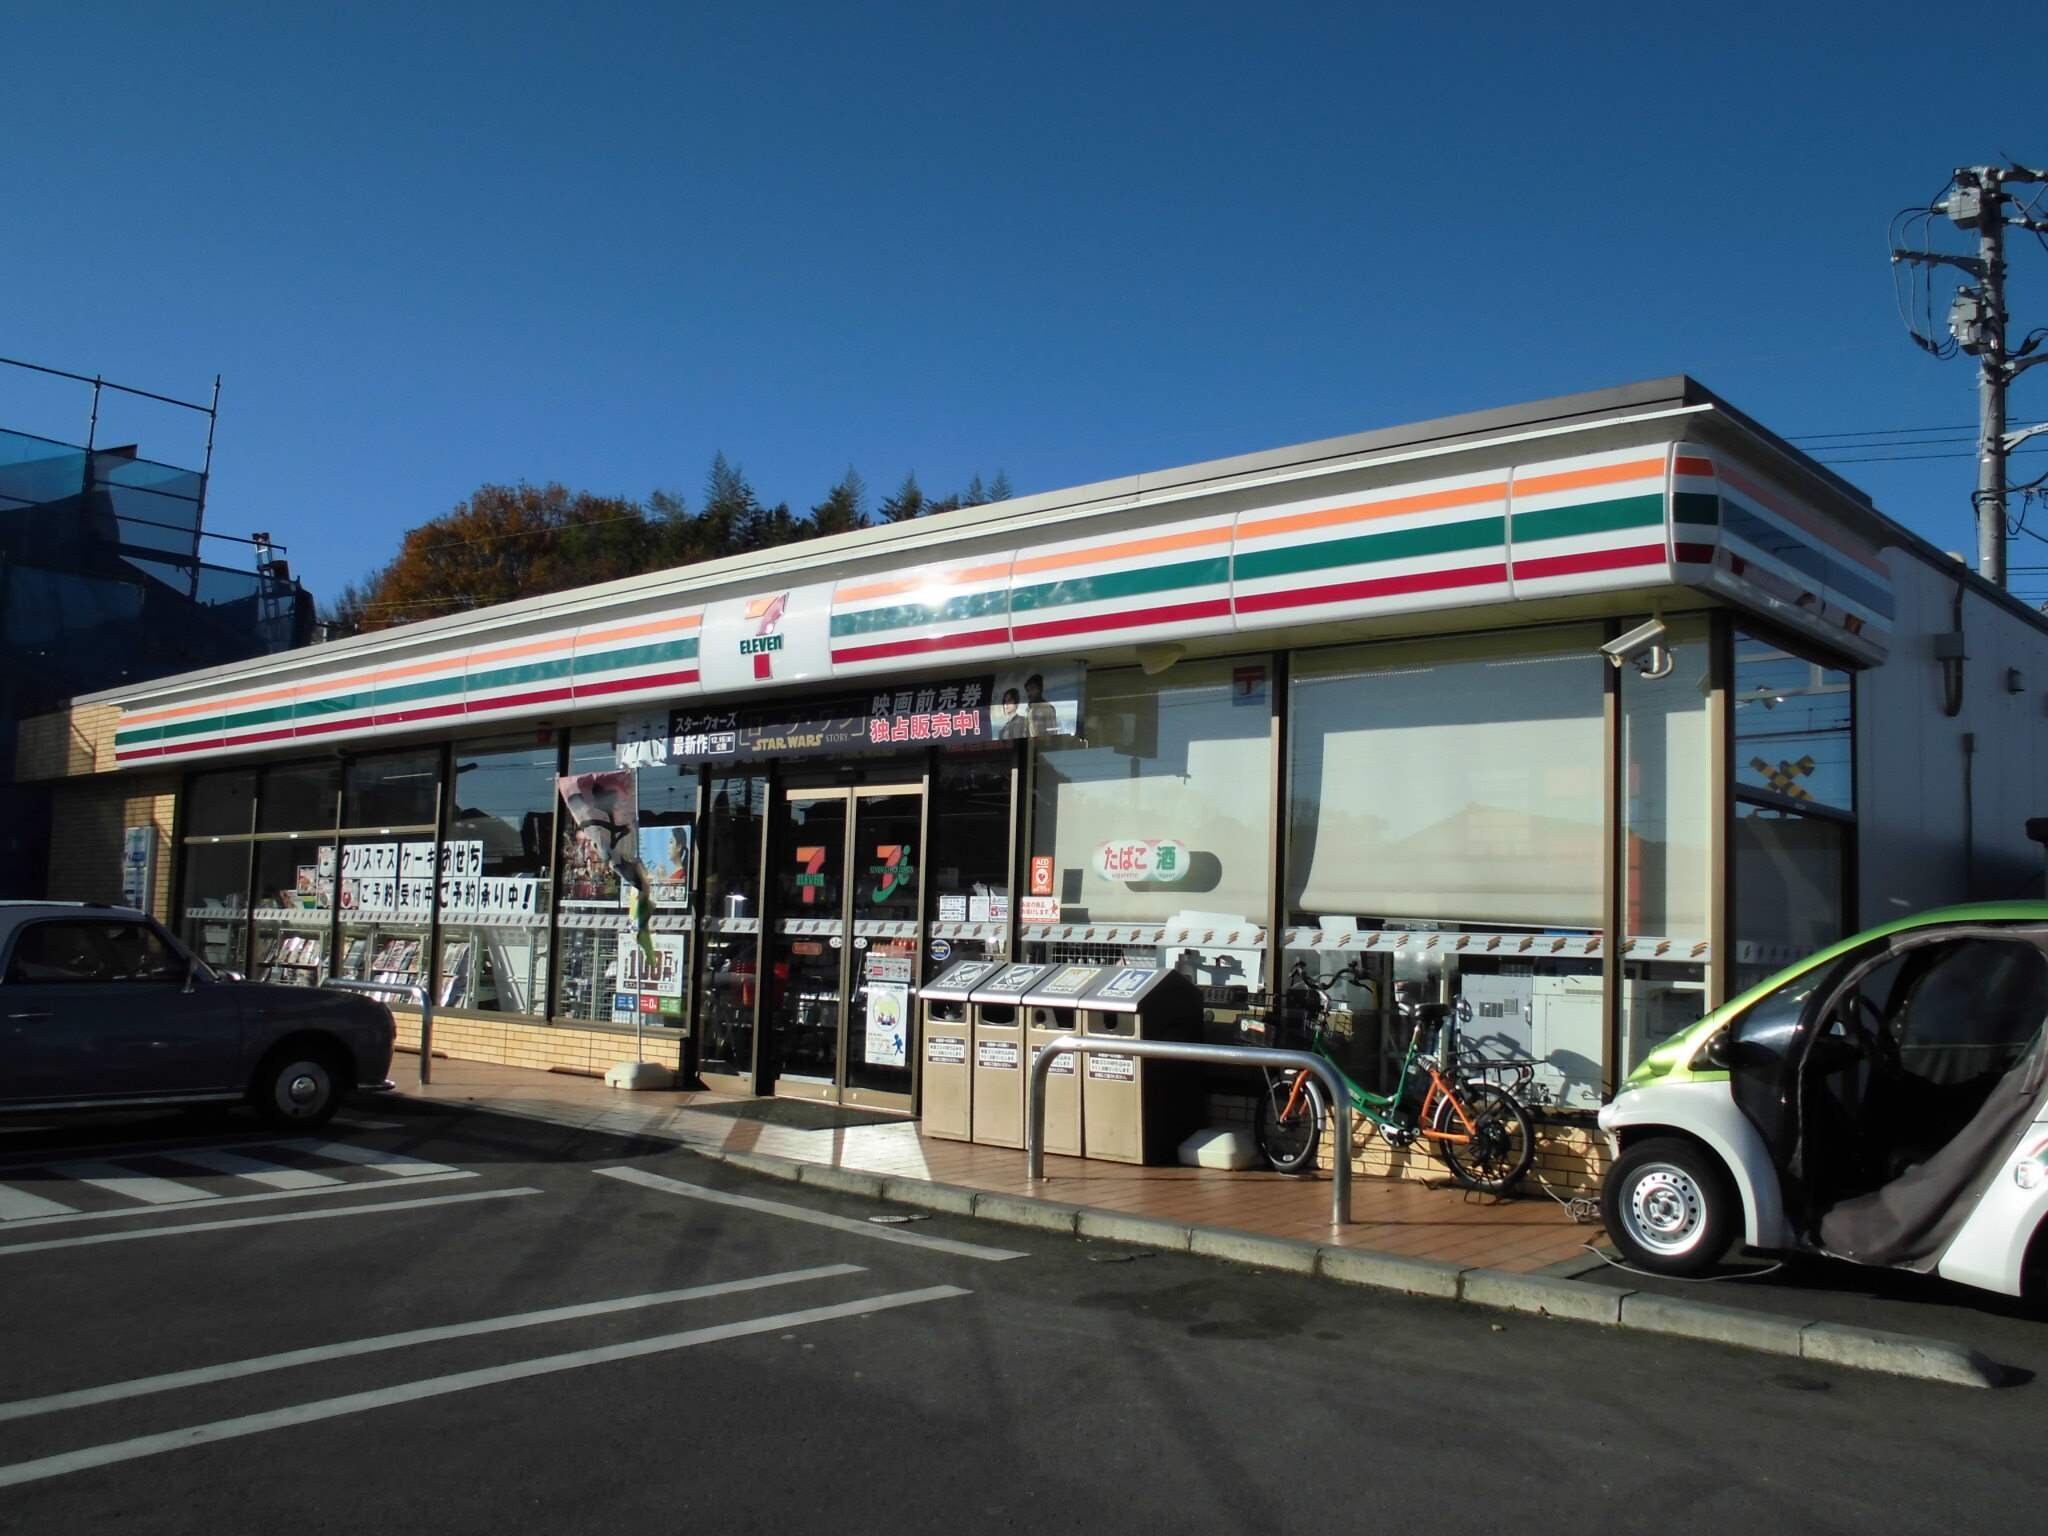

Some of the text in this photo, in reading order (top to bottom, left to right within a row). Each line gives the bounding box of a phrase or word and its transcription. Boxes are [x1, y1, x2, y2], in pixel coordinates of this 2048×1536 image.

[871, 683, 983, 717] 映画前売券
[673, 734, 708, 756] 最新作
[787, 734, 824, 748] WARS
[1104, 846, 1148, 870] たばこ
[1156, 846, 1176, 870] 酒
